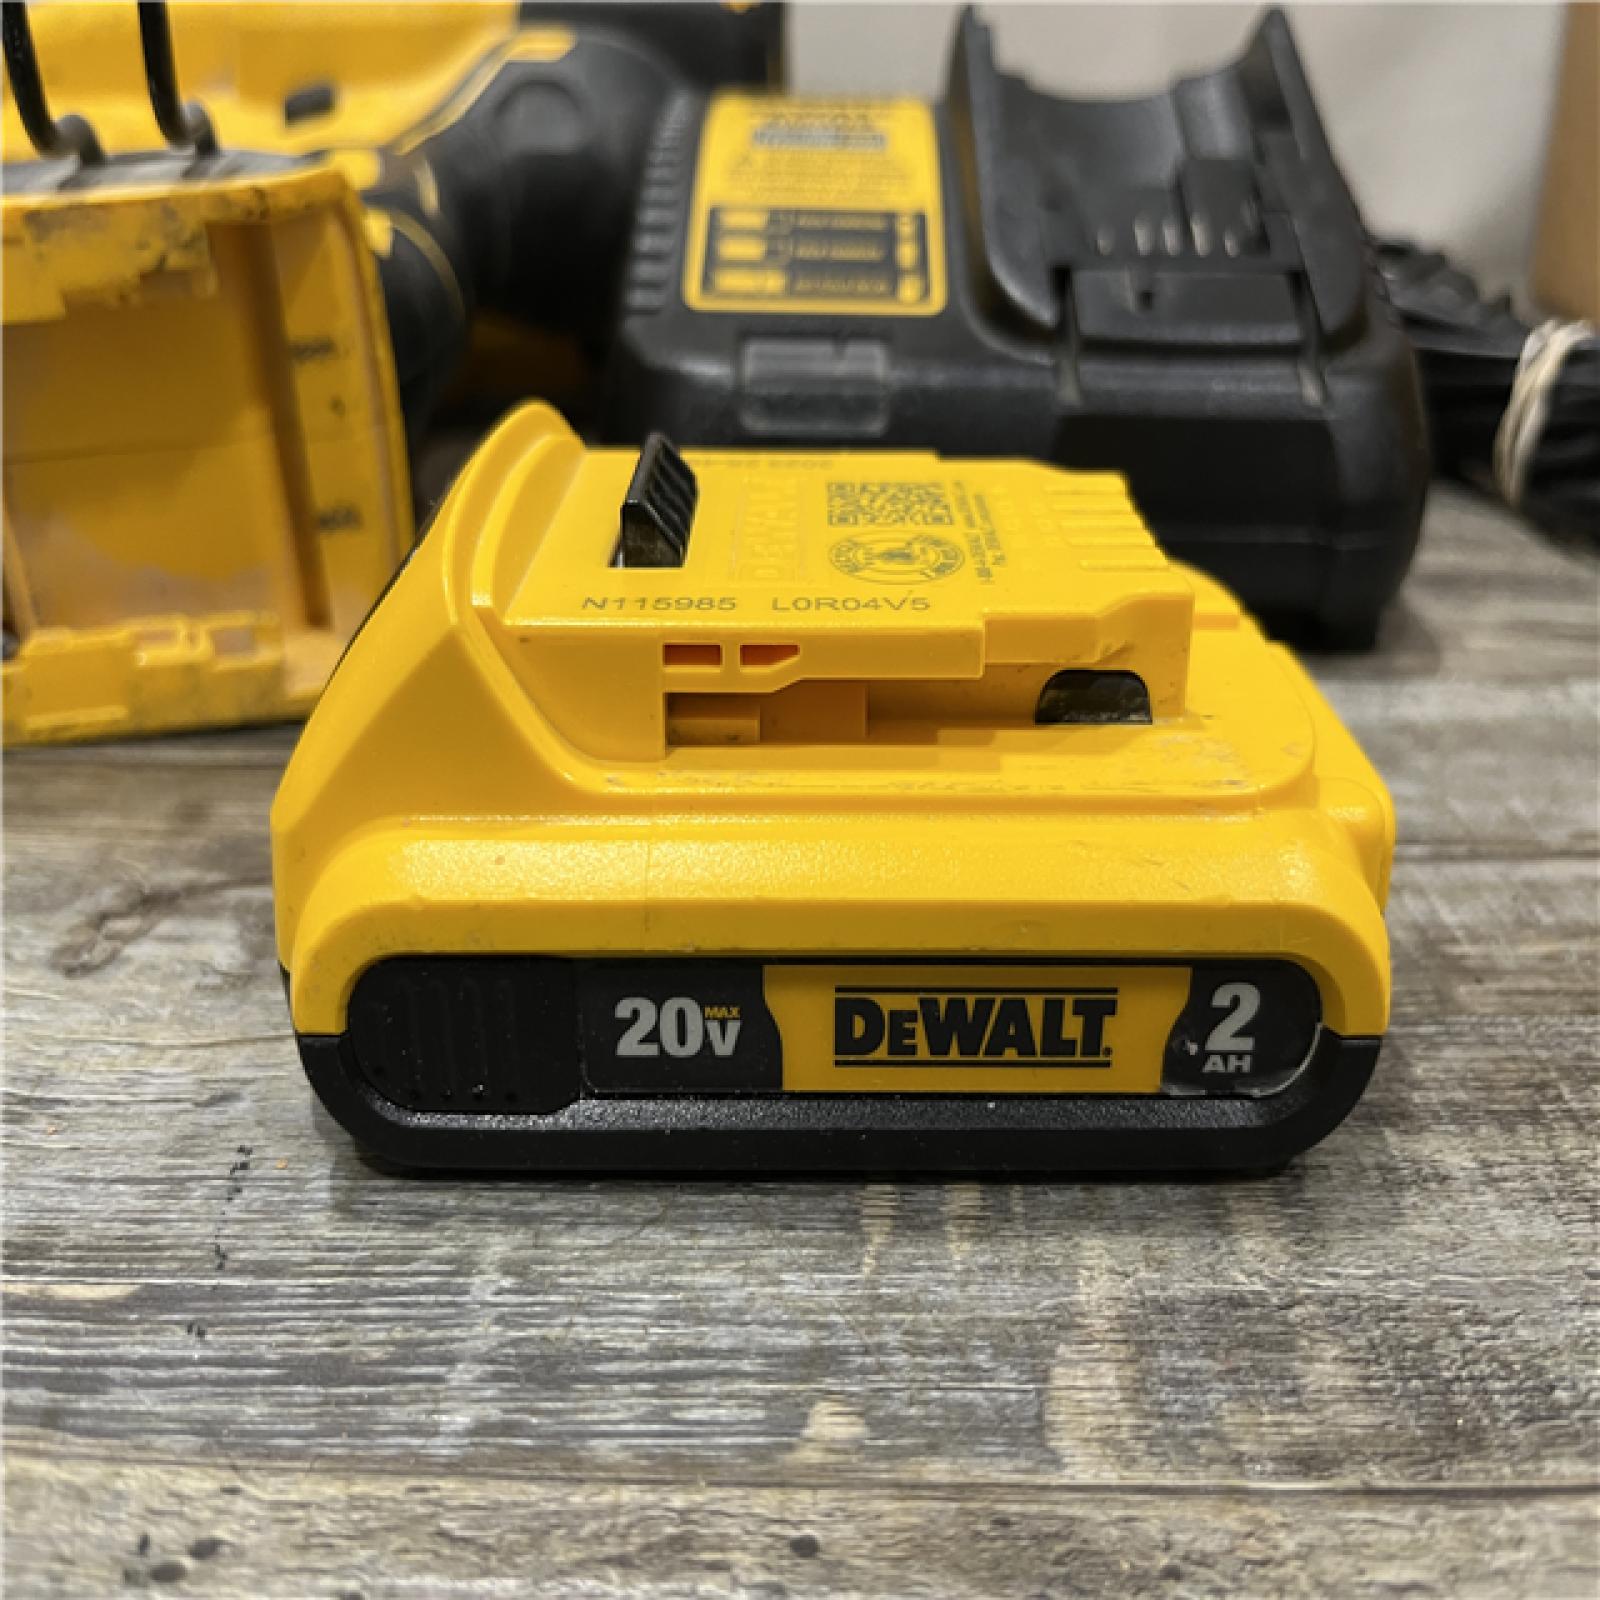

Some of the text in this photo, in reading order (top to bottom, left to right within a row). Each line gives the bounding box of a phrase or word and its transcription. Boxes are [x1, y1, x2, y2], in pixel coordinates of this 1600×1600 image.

[581, 596, 738, 611] N115985
[703, 1006, 740, 1018] MAX
[1205, 982, 1261, 1051] 2
[1201, 1053, 1251, 1073] AH
